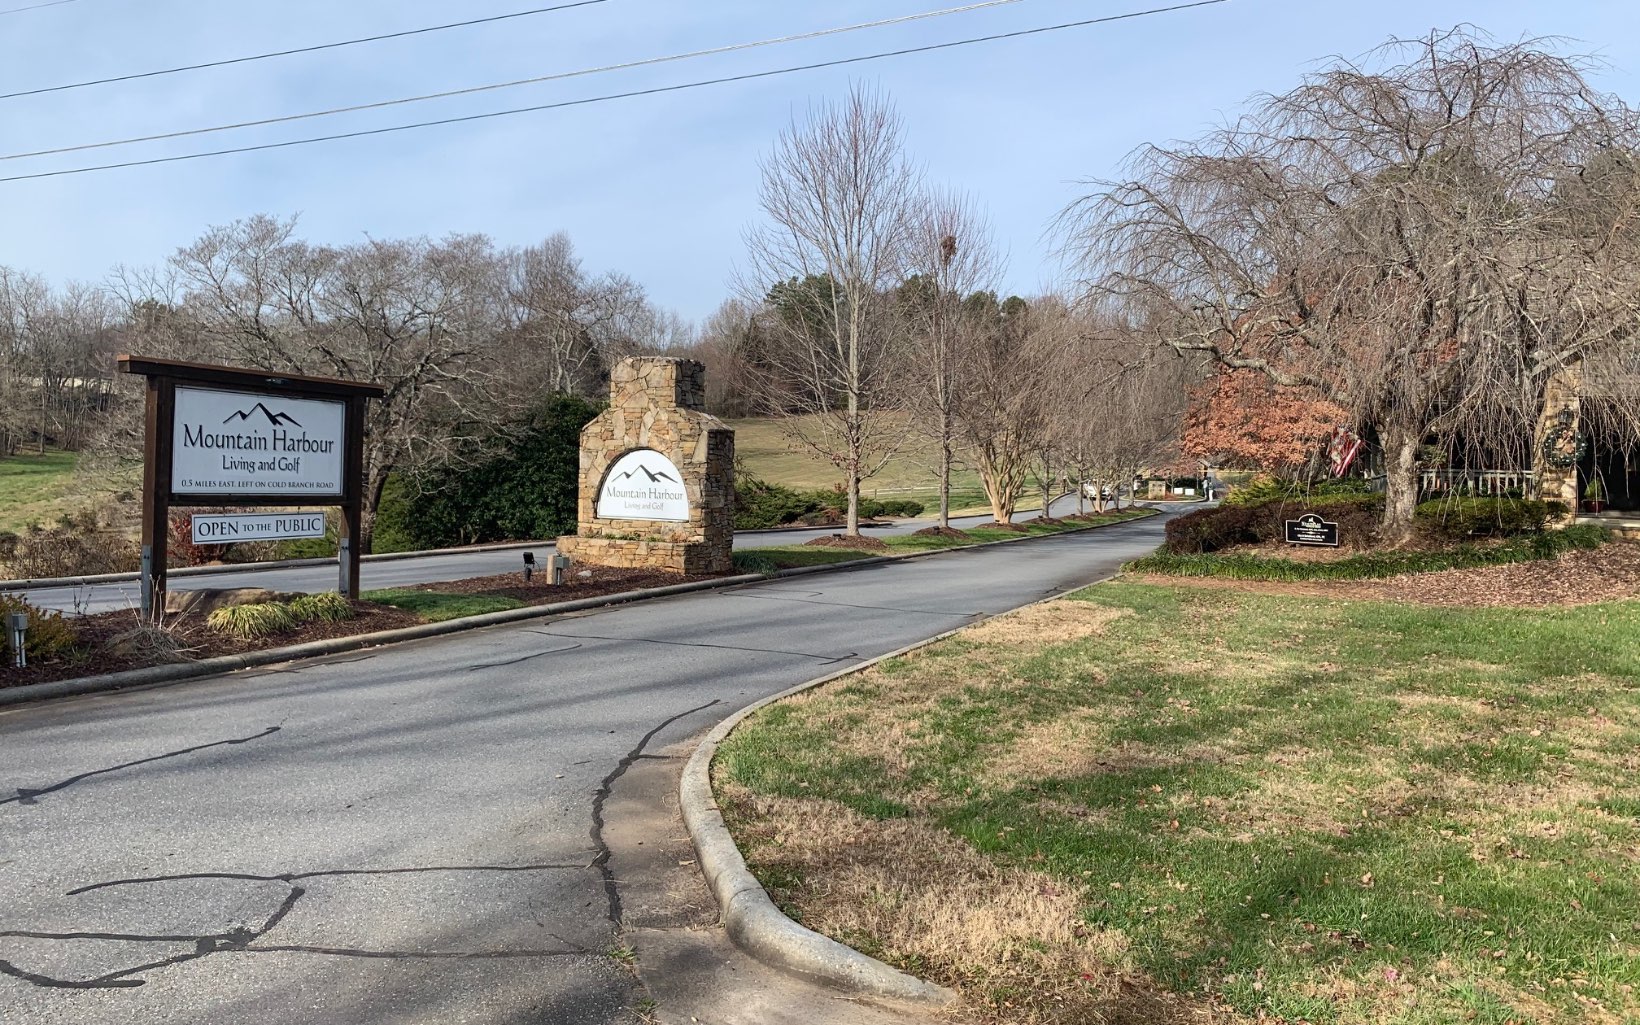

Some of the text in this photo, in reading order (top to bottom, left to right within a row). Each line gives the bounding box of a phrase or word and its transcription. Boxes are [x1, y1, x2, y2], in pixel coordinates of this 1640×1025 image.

[183, 423, 334, 453] Mountain Harbour
[222, 454, 301, 474] Living and Golf
[181, 479, 193, 487] 0.5
[194, 480, 217, 488] MILES
[238, 480, 253, 488] LEFT
[254, 480, 266, 488] ON
[288, 481, 315, 489] BRANCH
[316, 481, 334, 489] ROAD
[606, 486, 683, 500] Mountain Harbour
[198, 518, 321, 537] OPEN TO THE PUBLIC
